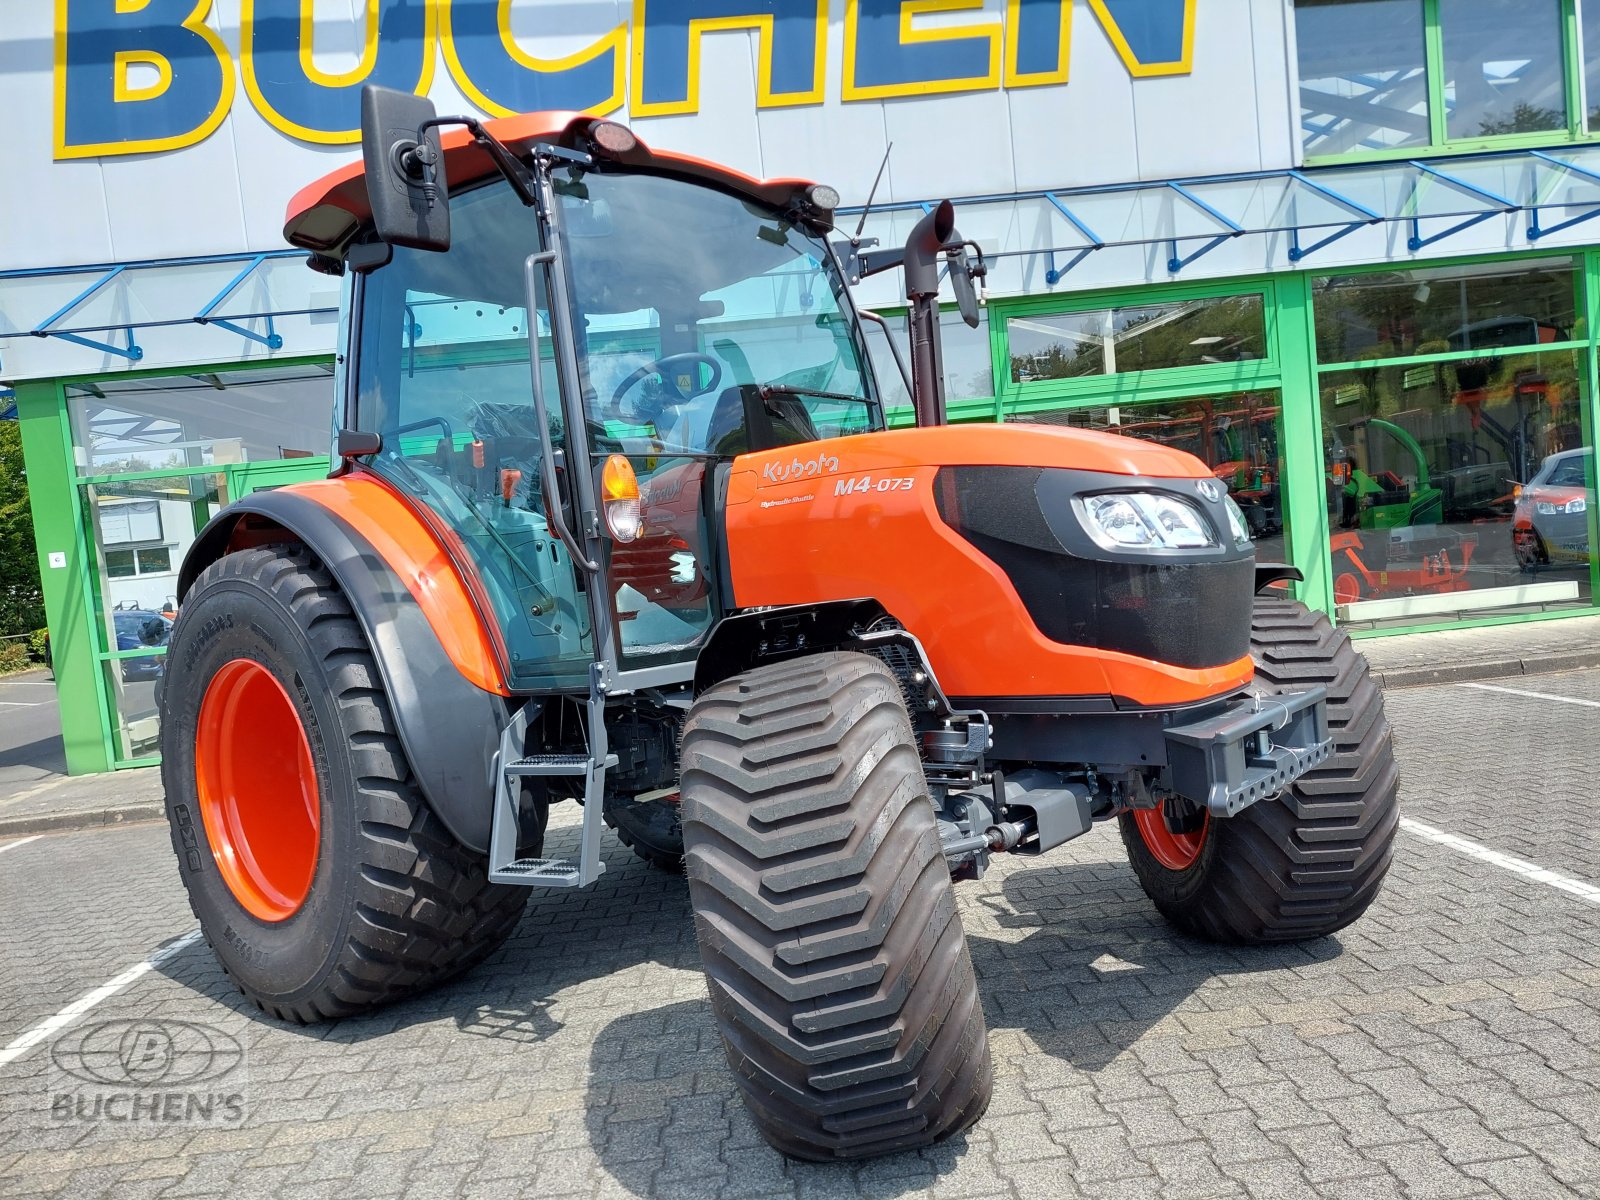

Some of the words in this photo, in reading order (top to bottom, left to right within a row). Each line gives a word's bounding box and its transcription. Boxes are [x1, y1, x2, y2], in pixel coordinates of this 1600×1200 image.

[762, 453, 839, 482] Kubota
[833, 475, 915, 497] M4-073
[760, 497, 792, 508] Hydraulic
[791, 494, 815, 503] Shuttle
[173, 803, 203, 872] BKT
